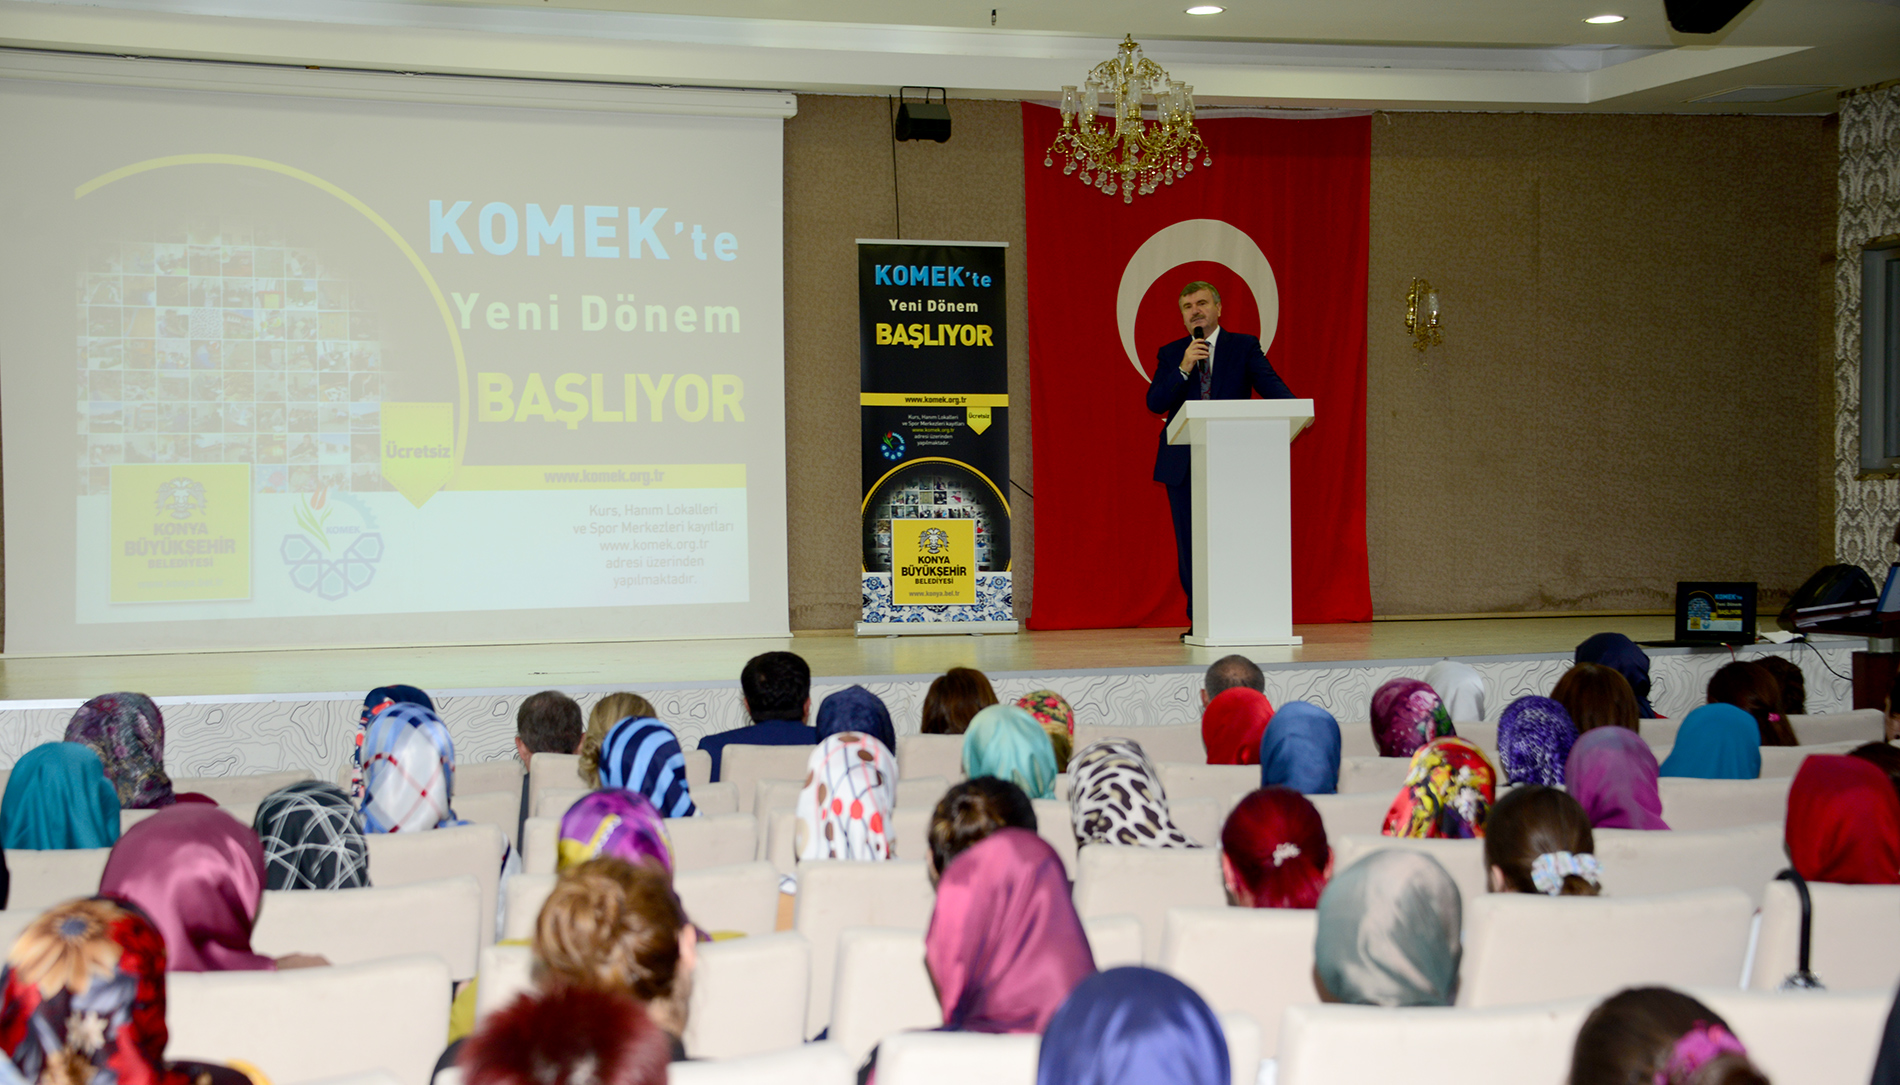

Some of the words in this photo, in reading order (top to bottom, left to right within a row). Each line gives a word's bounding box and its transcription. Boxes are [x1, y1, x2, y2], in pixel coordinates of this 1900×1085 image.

[429, 199, 739, 262] KOMEK'te
[874, 264, 992, 288] KOMEK'te
[451, 292, 560, 331] Yeni
[581, 293, 740, 334] Dönem
[888, 299, 922, 312] Yeni
[927, 299, 979, 313] Dönem
[875, 322, 994, 349] BAŞLIYOR
[477, 372, 746, 430] BAŞLIYOR
[904, 396, 967, 405] www.komek.org.tr
[385, 440, 451, 459] Ücretsiz
[544, 468, 665, 486] www.komek.org.tr
[588, 504, 622, 518] Kurs,
[624, 503, 664, 517] Hanım
[666, 502, 719, 516] Lokalleri
[153, 522, 209, 536] KONYA
[326, 526, 361, 535] KOMEK
[572, 524, 587, 535] ve
[589, 522, 619, 537] Spor
[621, 520, 685, 534] Merkezleri
[687, 520, 734, 535] kayıtları
[124, 535, 236, 558] BÜYÜKŞEHİR
[599, 538, 710, 553] www.komek.org.tr
[147, 556, 214, 569] BELEDİYESİ
[605, 556, 643, 569] adresi
[645, 555, 705, 568] üzerinden
[917, 555, 951, 564] KONYA
[901, 564, 967, 578] BÜYÜKŞEHİR
[612, 572, 698, 589] yapılmaktadır.
[914, 576, 954, 585] BELEDİYESİ
[908, 590, 960, 598] www.konya.bel.tr
